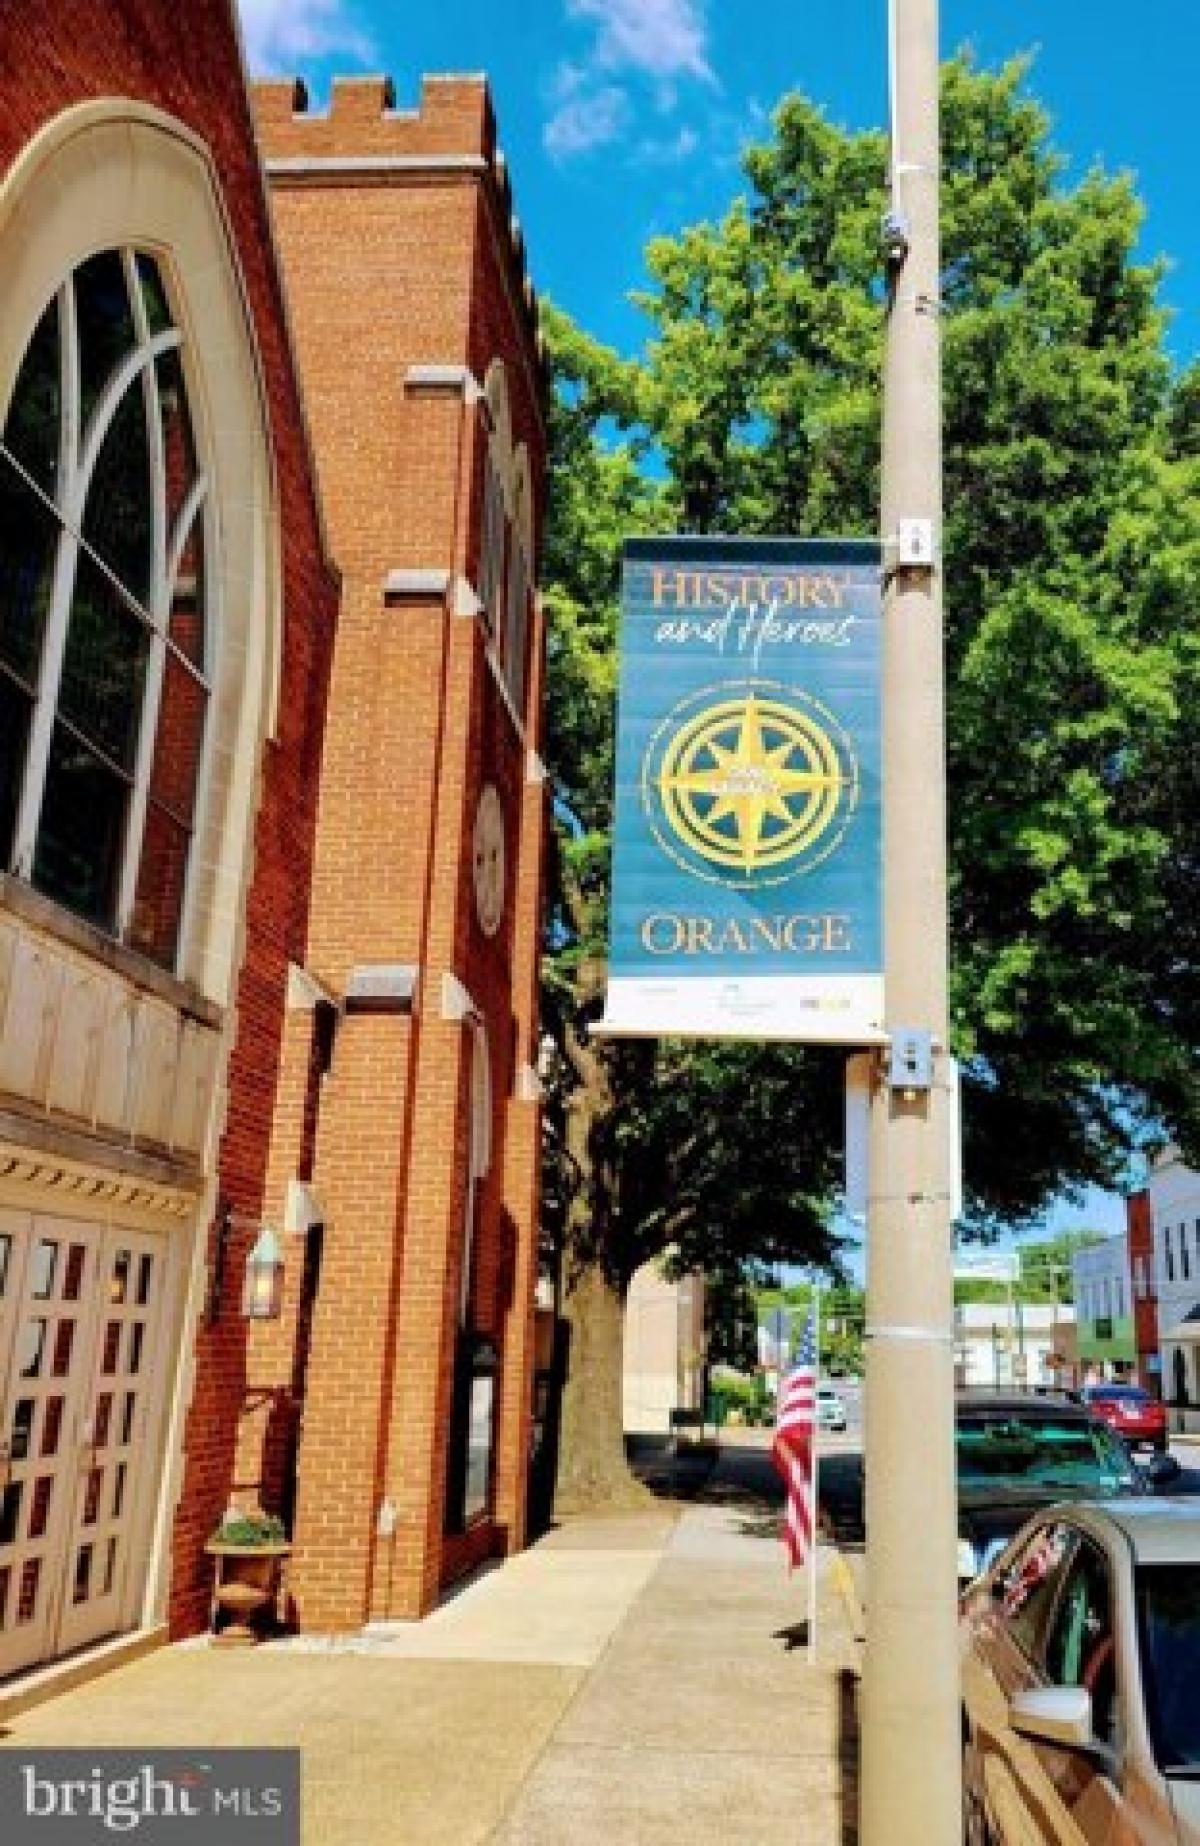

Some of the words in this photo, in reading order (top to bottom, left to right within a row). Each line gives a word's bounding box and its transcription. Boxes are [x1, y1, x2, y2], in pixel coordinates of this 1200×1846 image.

[652, 568, 850, 609] HISTORY
[654, 596, 739, 655] and
[736, 600, 858, 672] Heroes
[641, 911, 851, 954] ORANGE
